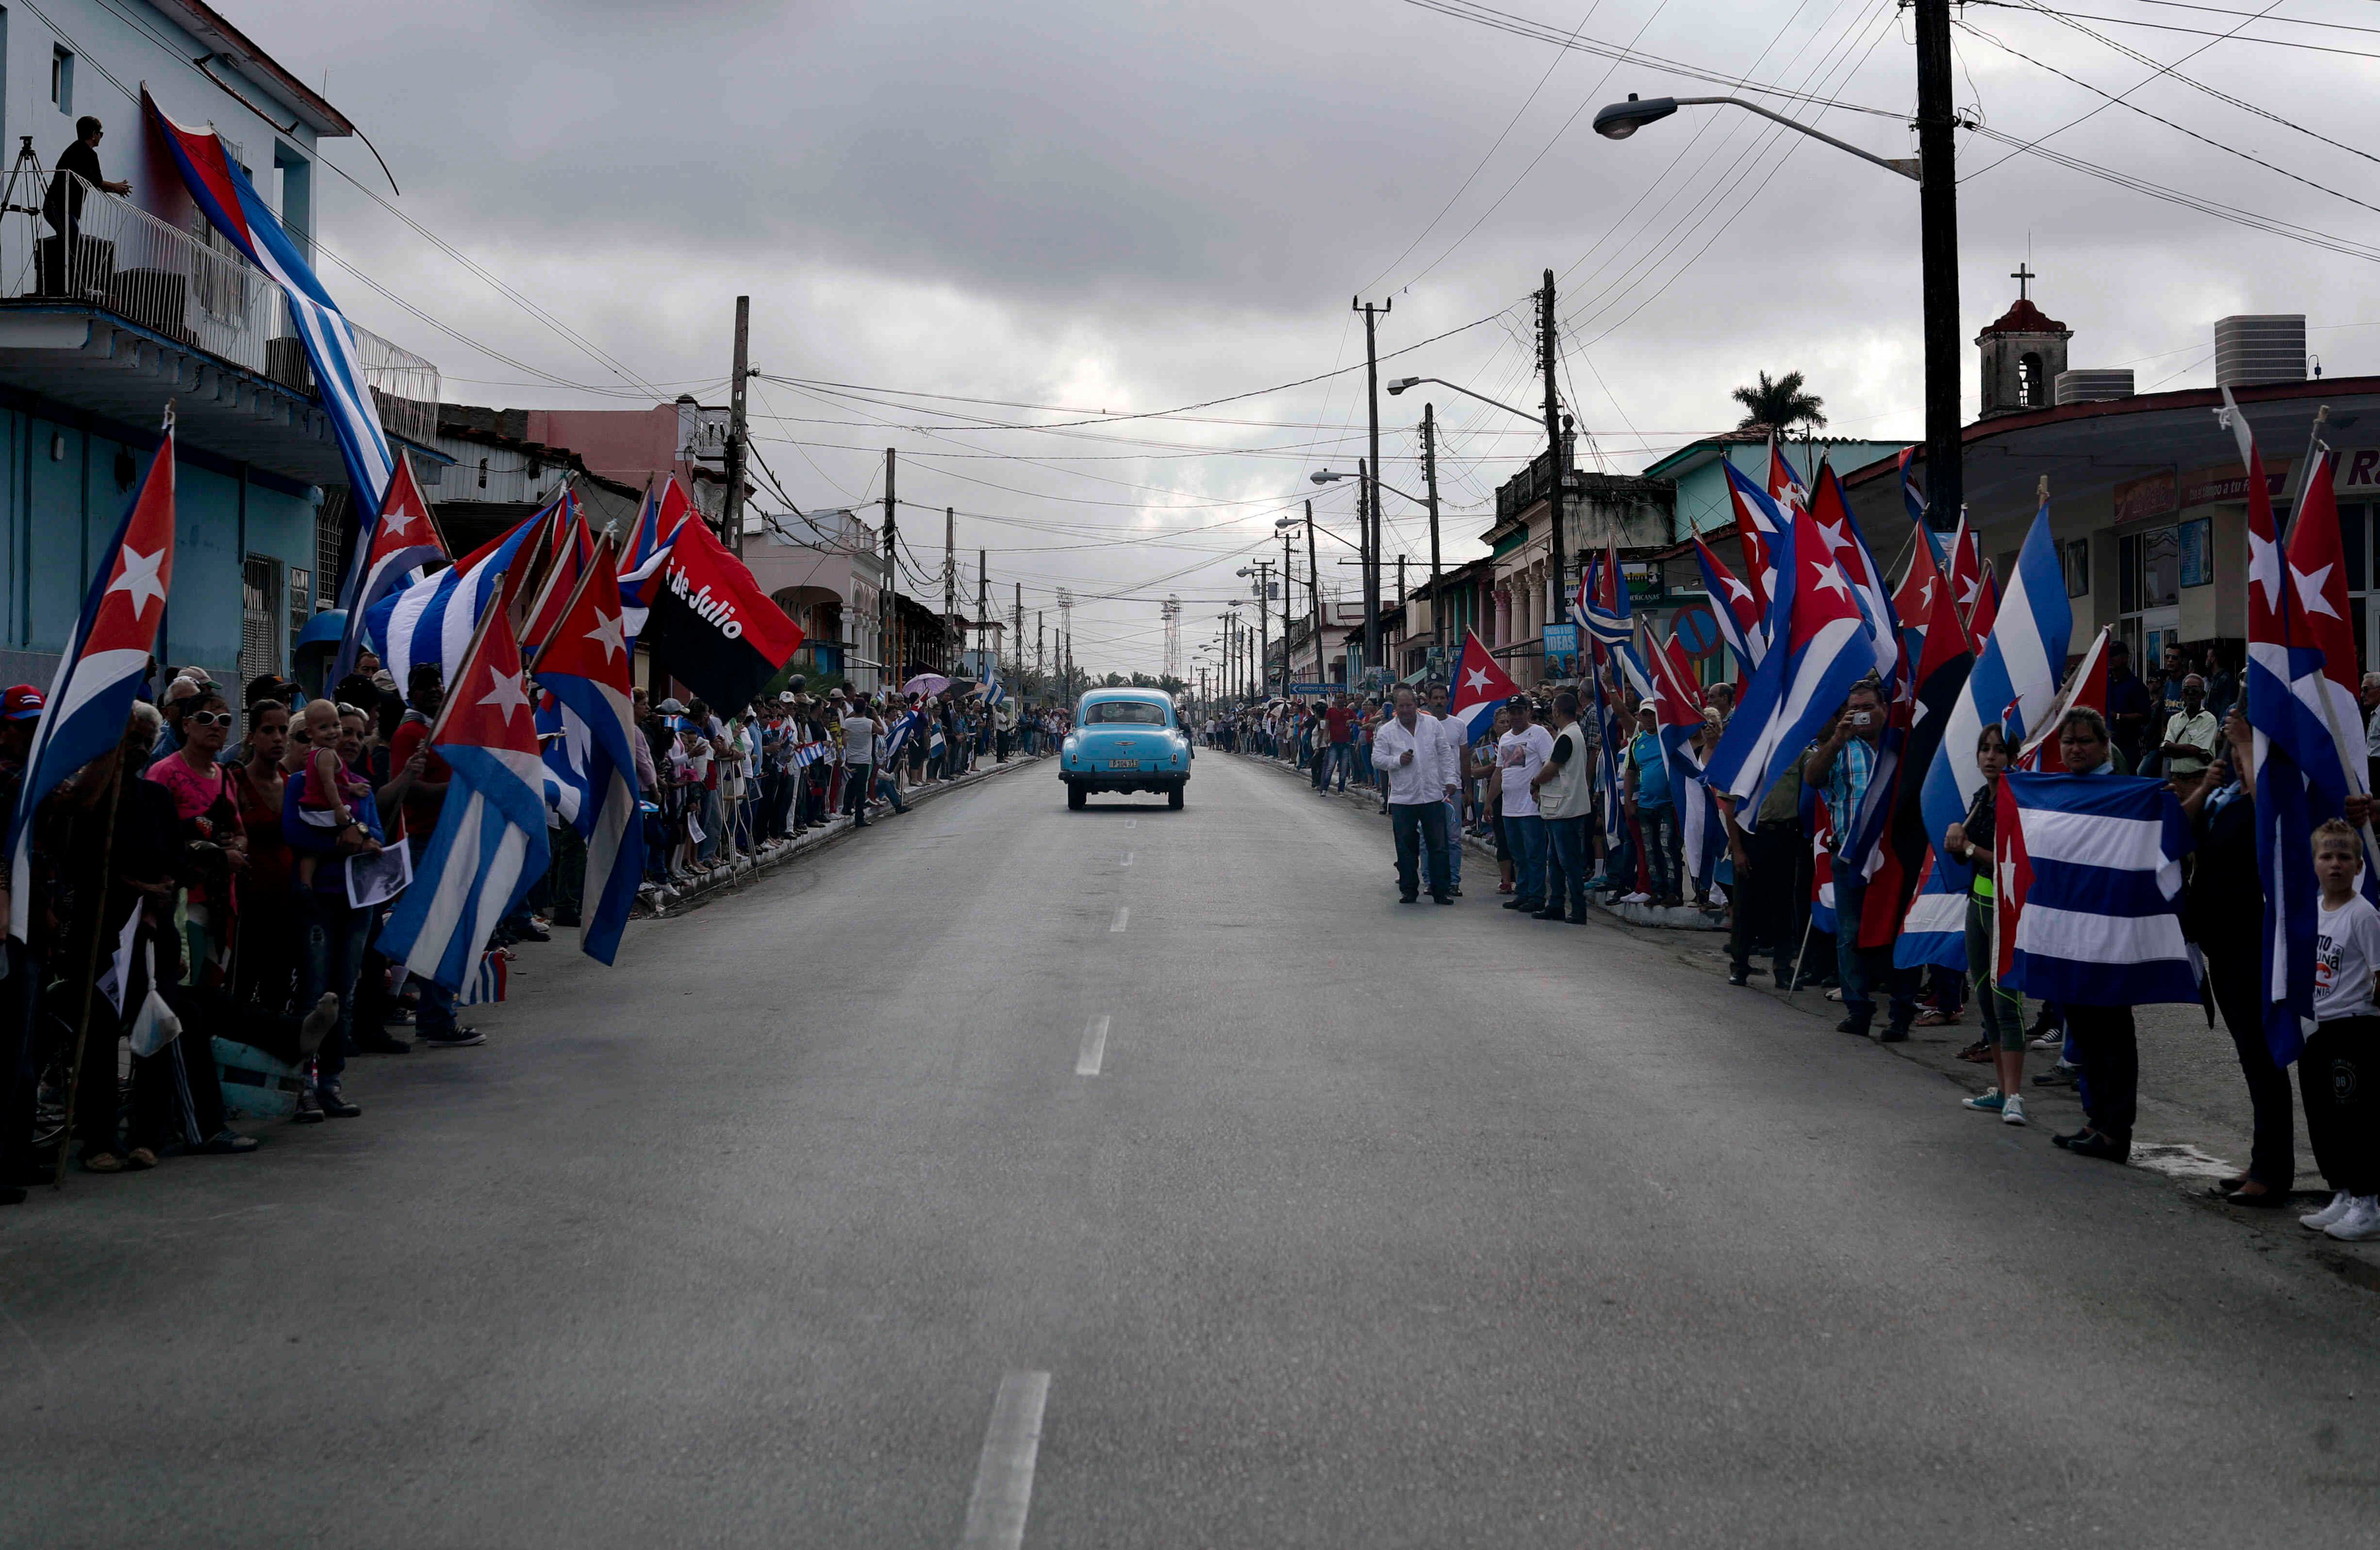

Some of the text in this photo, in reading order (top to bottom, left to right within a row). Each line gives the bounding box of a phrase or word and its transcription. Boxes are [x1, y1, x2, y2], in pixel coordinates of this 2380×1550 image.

[2347, 450, 2380, 485] R
[2223, 482, 2229, 494] a
[2231, 480, 2241, 493] tu
[671, 565, 689, 600] de
[688, 584, 742, 639] Julio
[1546, 635, 1575, 651] IDEAS
